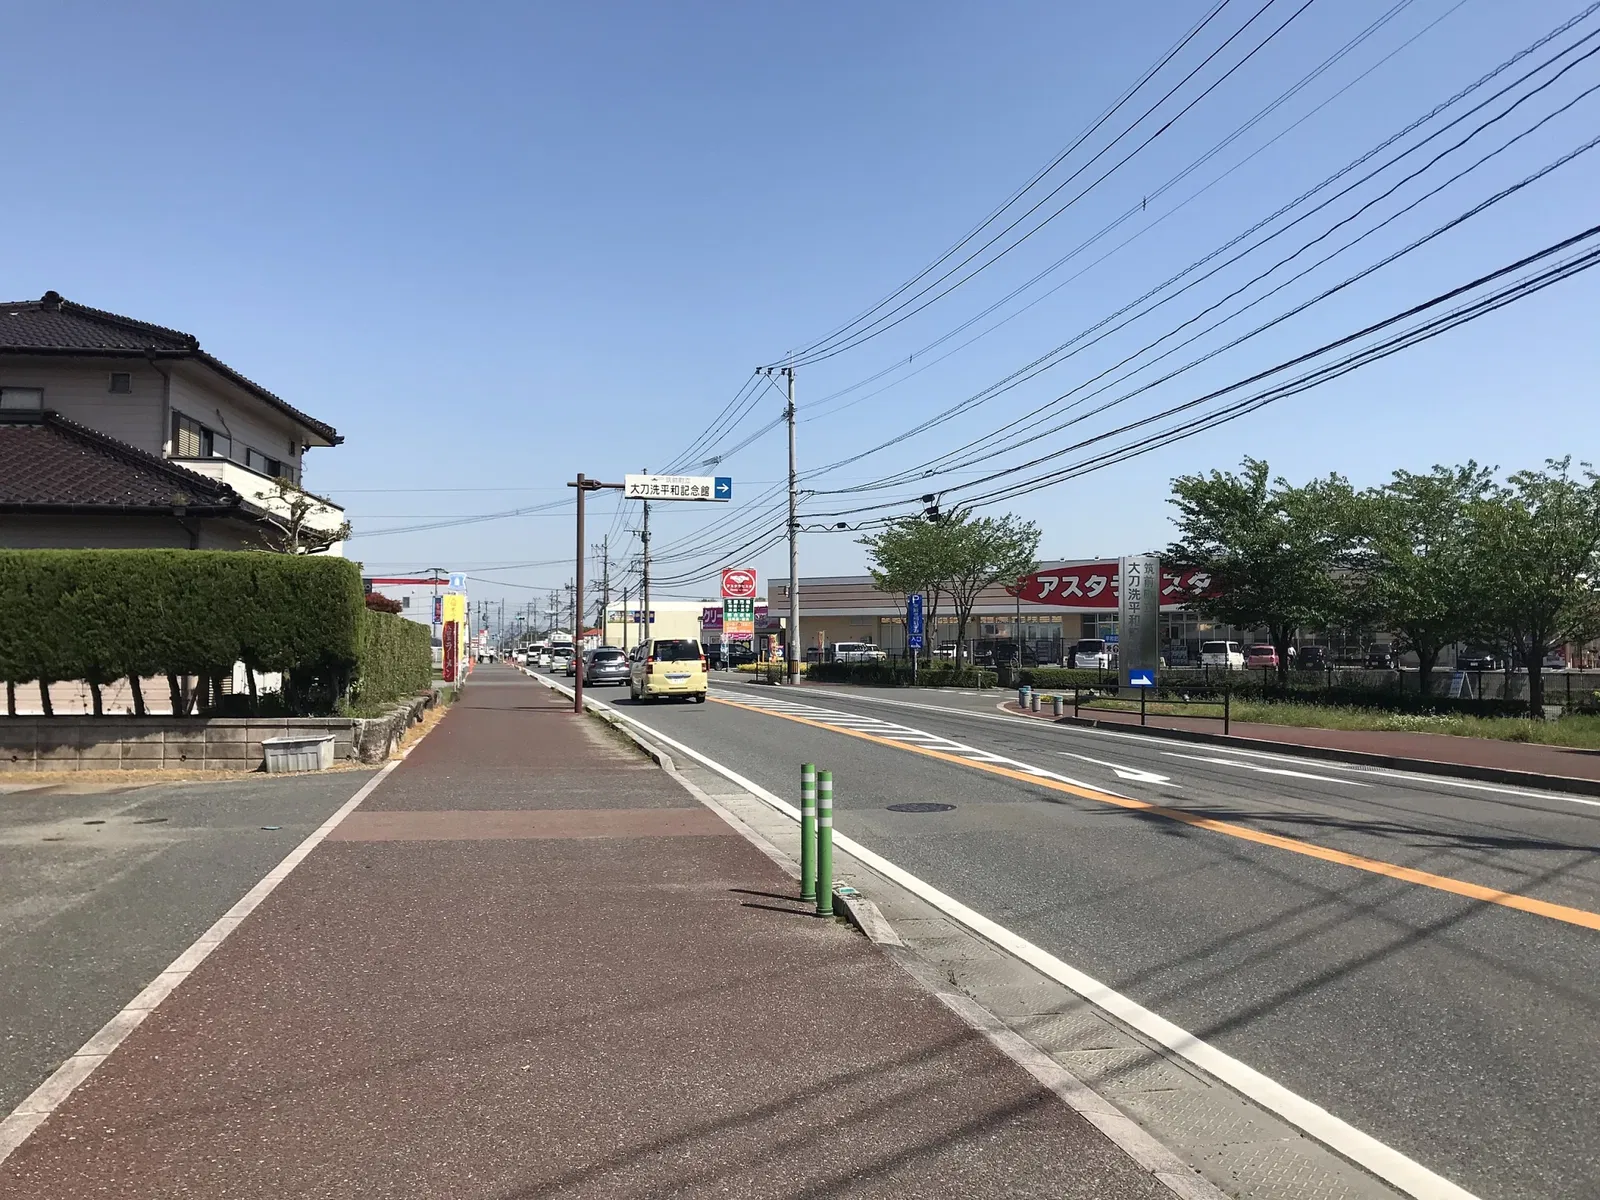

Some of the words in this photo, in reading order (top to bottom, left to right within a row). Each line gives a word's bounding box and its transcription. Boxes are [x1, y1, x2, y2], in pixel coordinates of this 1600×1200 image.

[630, 484, 710, 497] 大刀洗平和記念館
[912, 595, 919, 604] P
